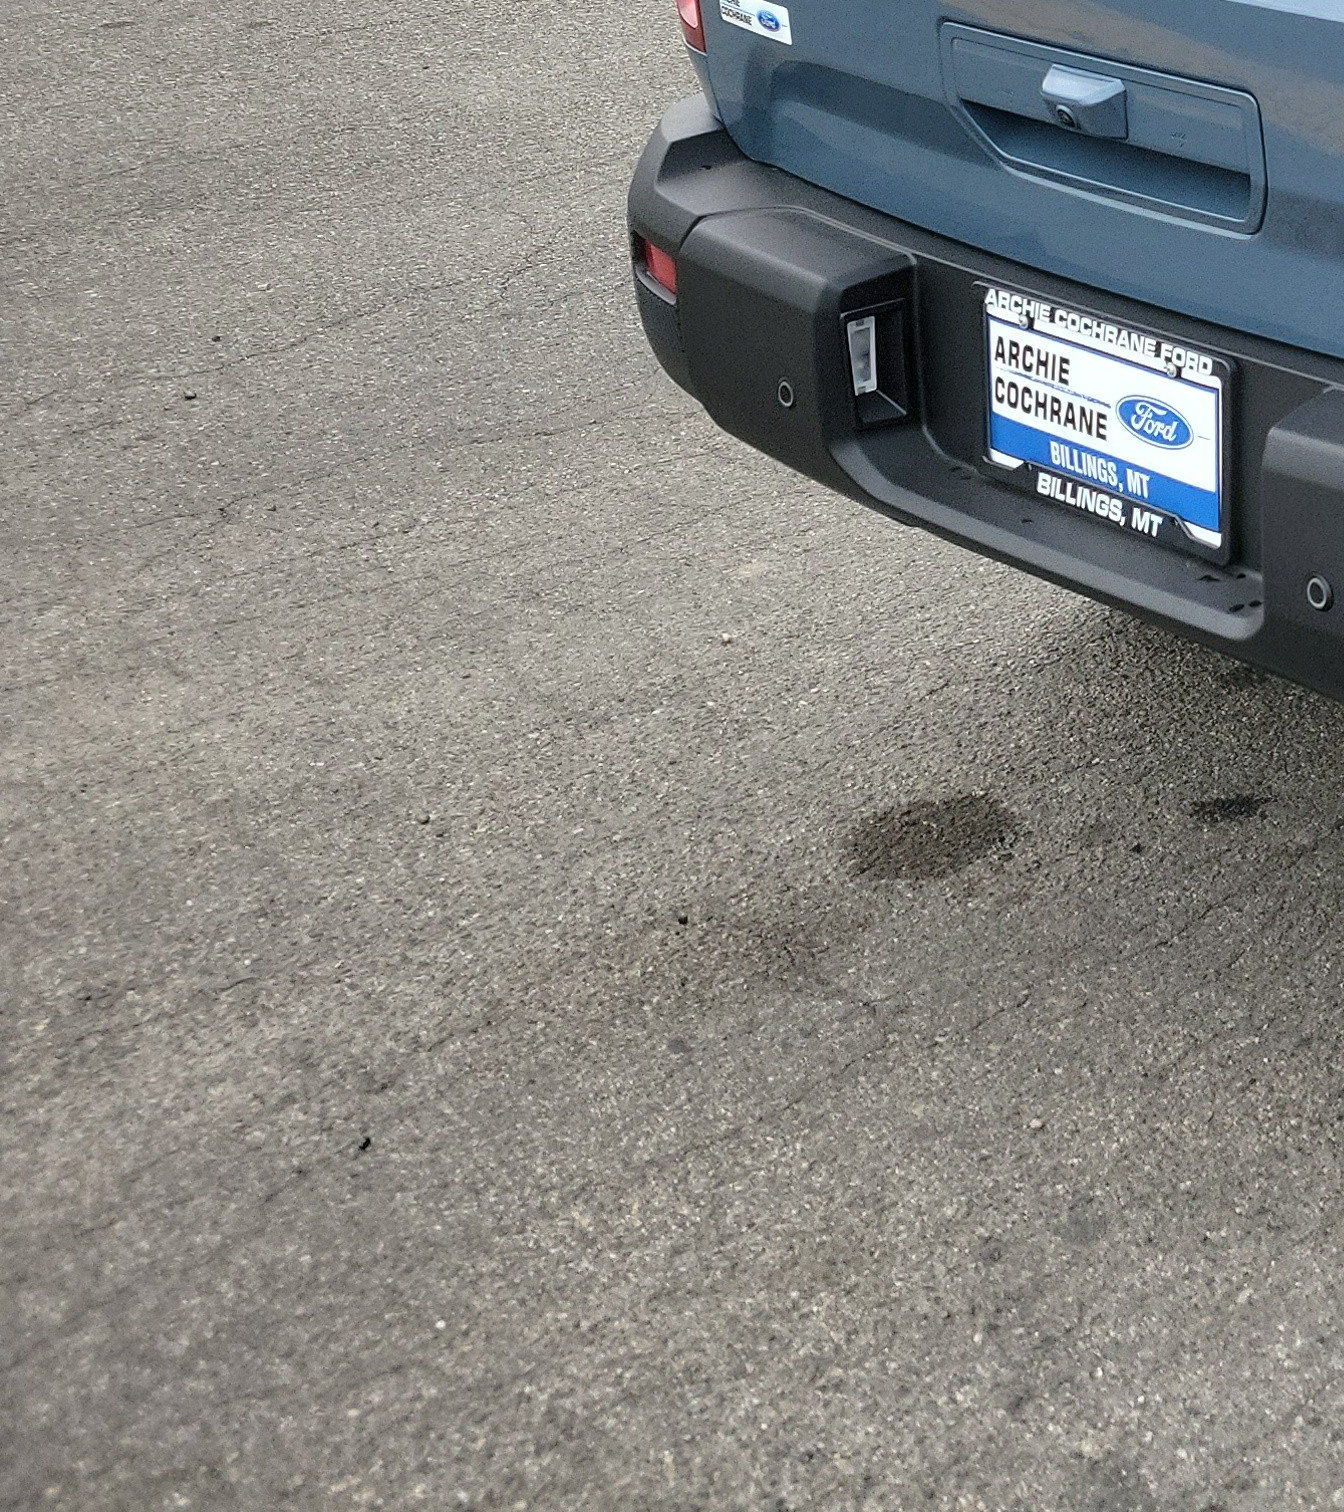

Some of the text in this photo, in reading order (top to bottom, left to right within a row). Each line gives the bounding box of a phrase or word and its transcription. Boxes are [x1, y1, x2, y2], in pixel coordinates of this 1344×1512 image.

[984, 288, 1213, 376] ARCHIE COCHRANE FORD
[994, 335, 1071, 386] ARCHIE
[994, 376, 1108, 442] COCHRANE
[1131, 400, 1179, 443] Ford
[1050, 440, 1151, 499] BILLINGS, MT
[1036, 471, 1163, 538] BILLINGS, MT
